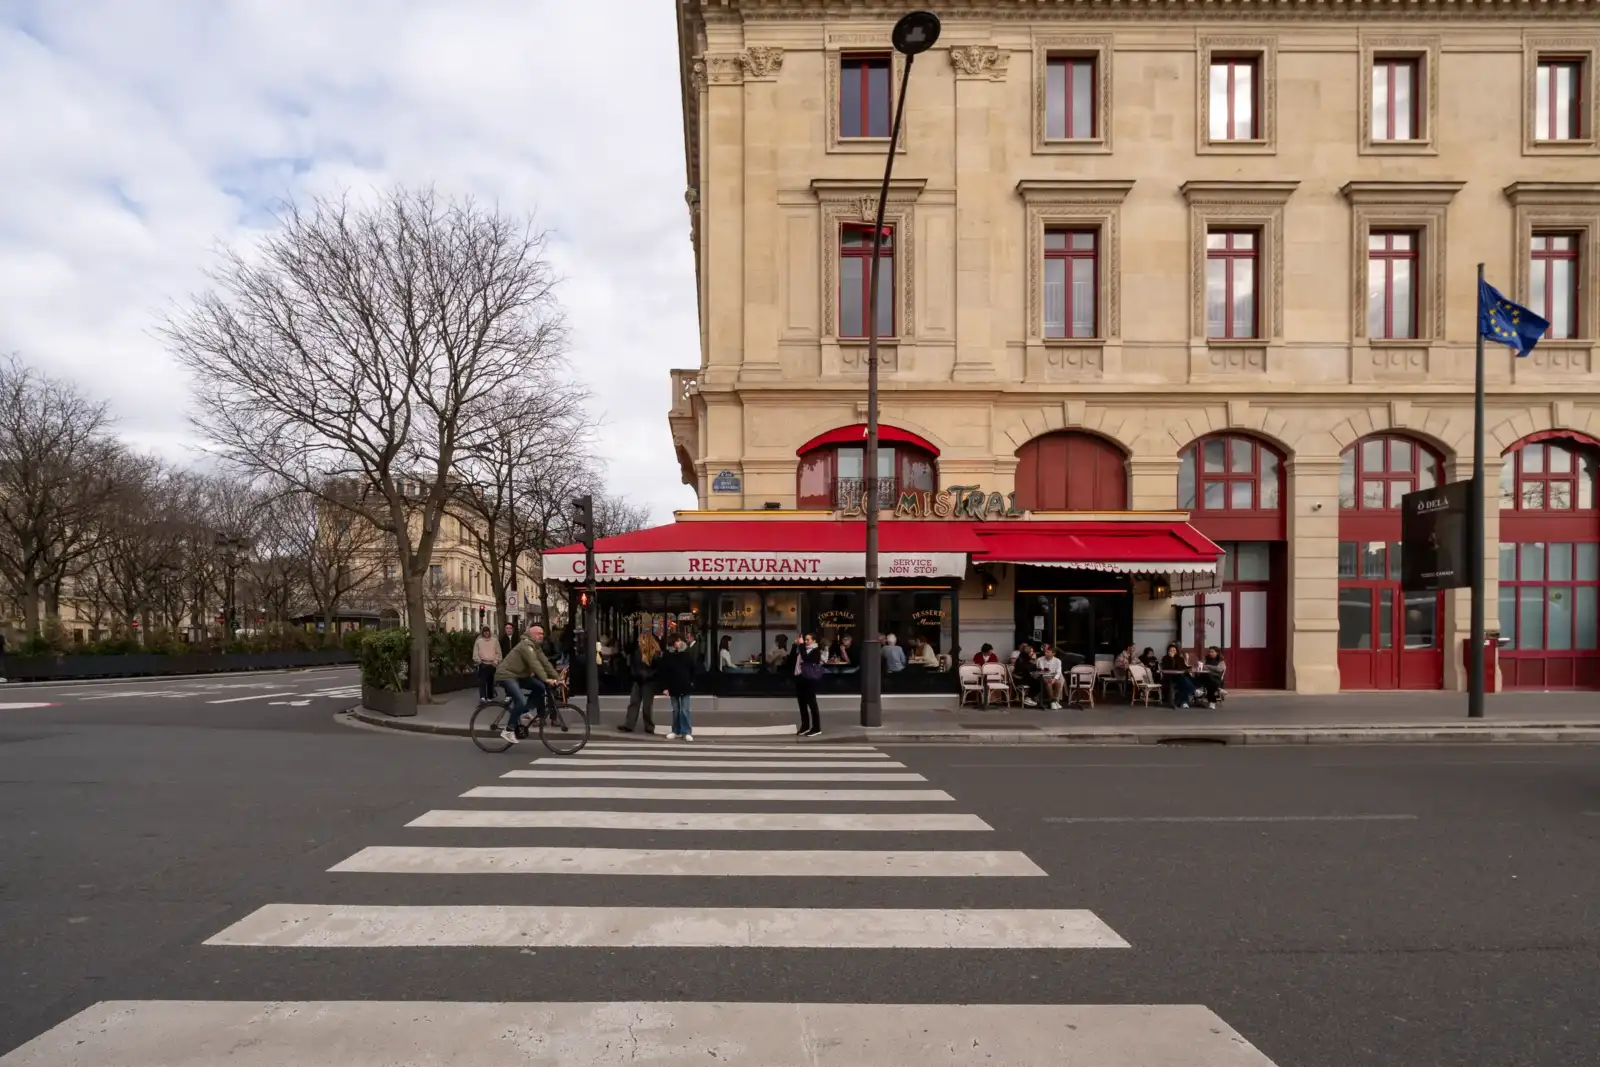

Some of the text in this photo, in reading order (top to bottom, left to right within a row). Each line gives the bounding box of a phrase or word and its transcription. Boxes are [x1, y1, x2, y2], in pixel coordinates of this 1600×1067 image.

[895, 484, 1026, 521] MISTRAL
[688, 558, 821, 573] RESTAURANT
[893, 558, 932, 567] SERVICE
[889, 566, 938, 574] NON STOP
